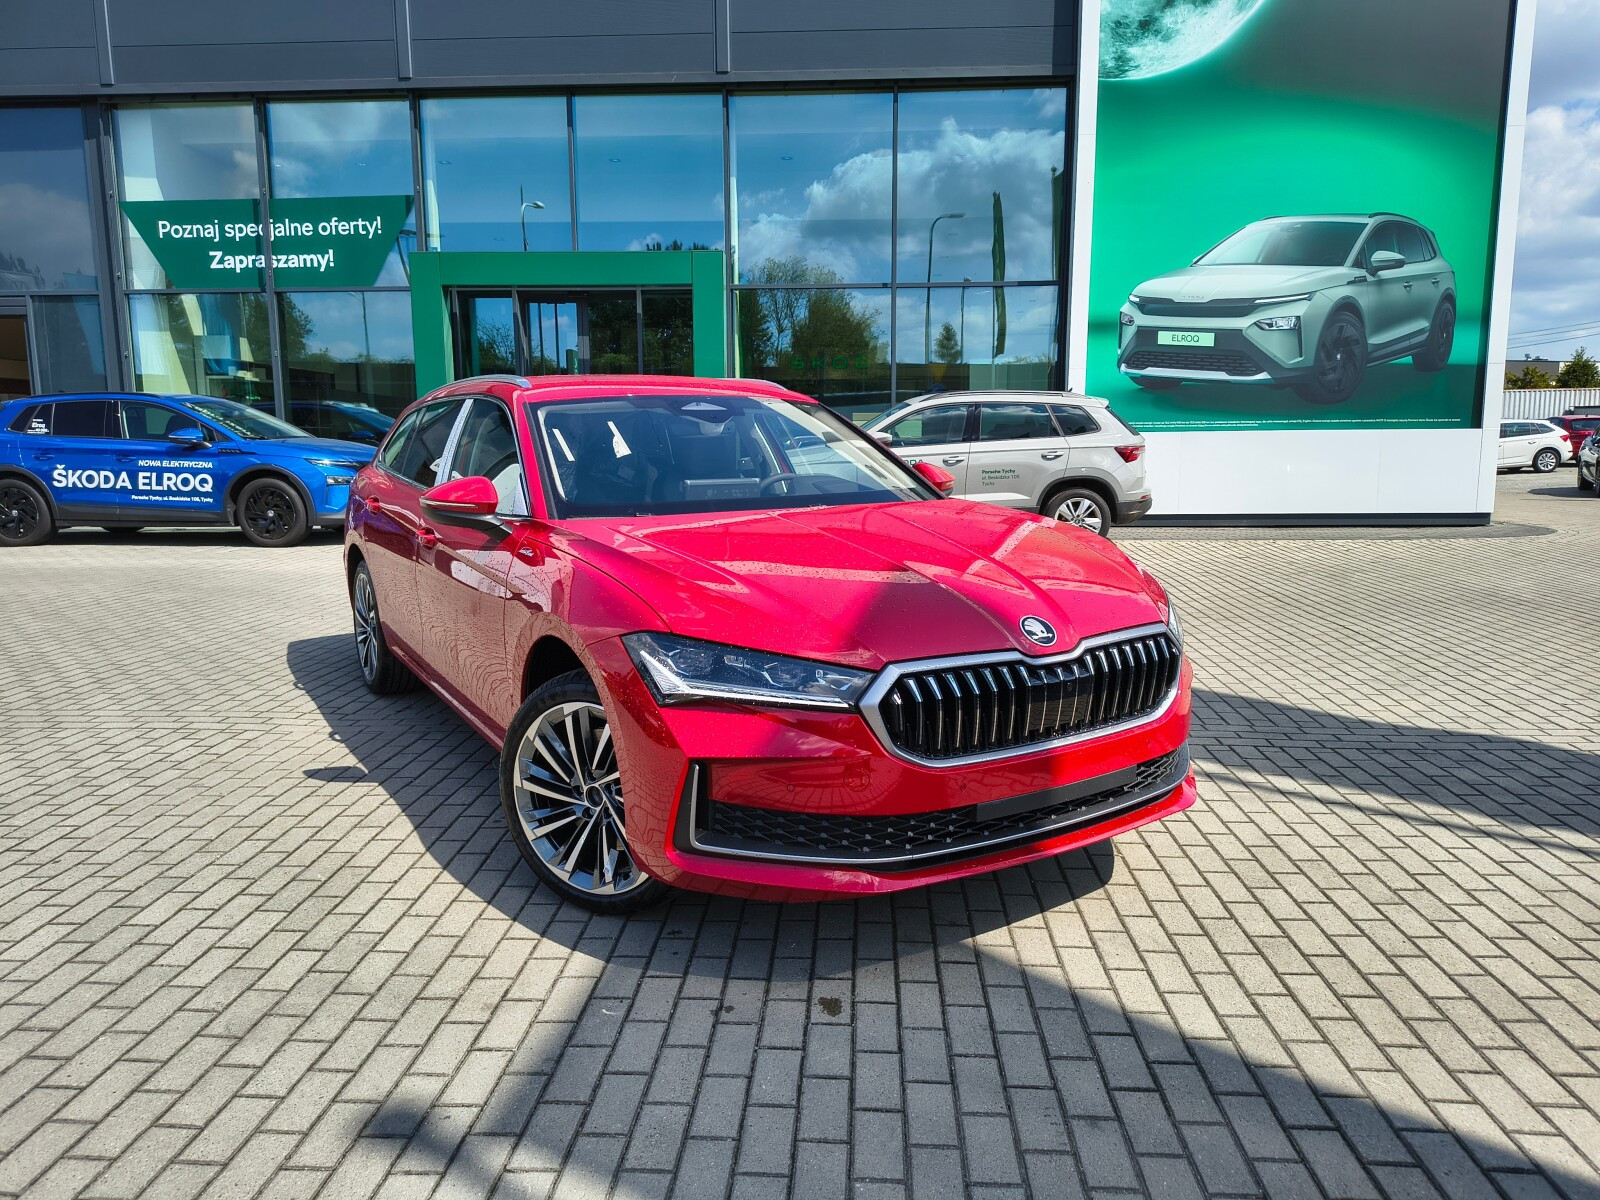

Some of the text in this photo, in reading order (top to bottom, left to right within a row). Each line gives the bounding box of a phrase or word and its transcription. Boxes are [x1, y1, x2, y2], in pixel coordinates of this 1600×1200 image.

[158, 219, 220, 242] Poznaj
[318, 216, 382, 240] oferty!
[1171, 333, 1200, 343] ELROQ
[138, 459, 213, 469] NOWA ELEKTRYCZNA
[52, 463, 213, 493] ŠKODA ELROQ
